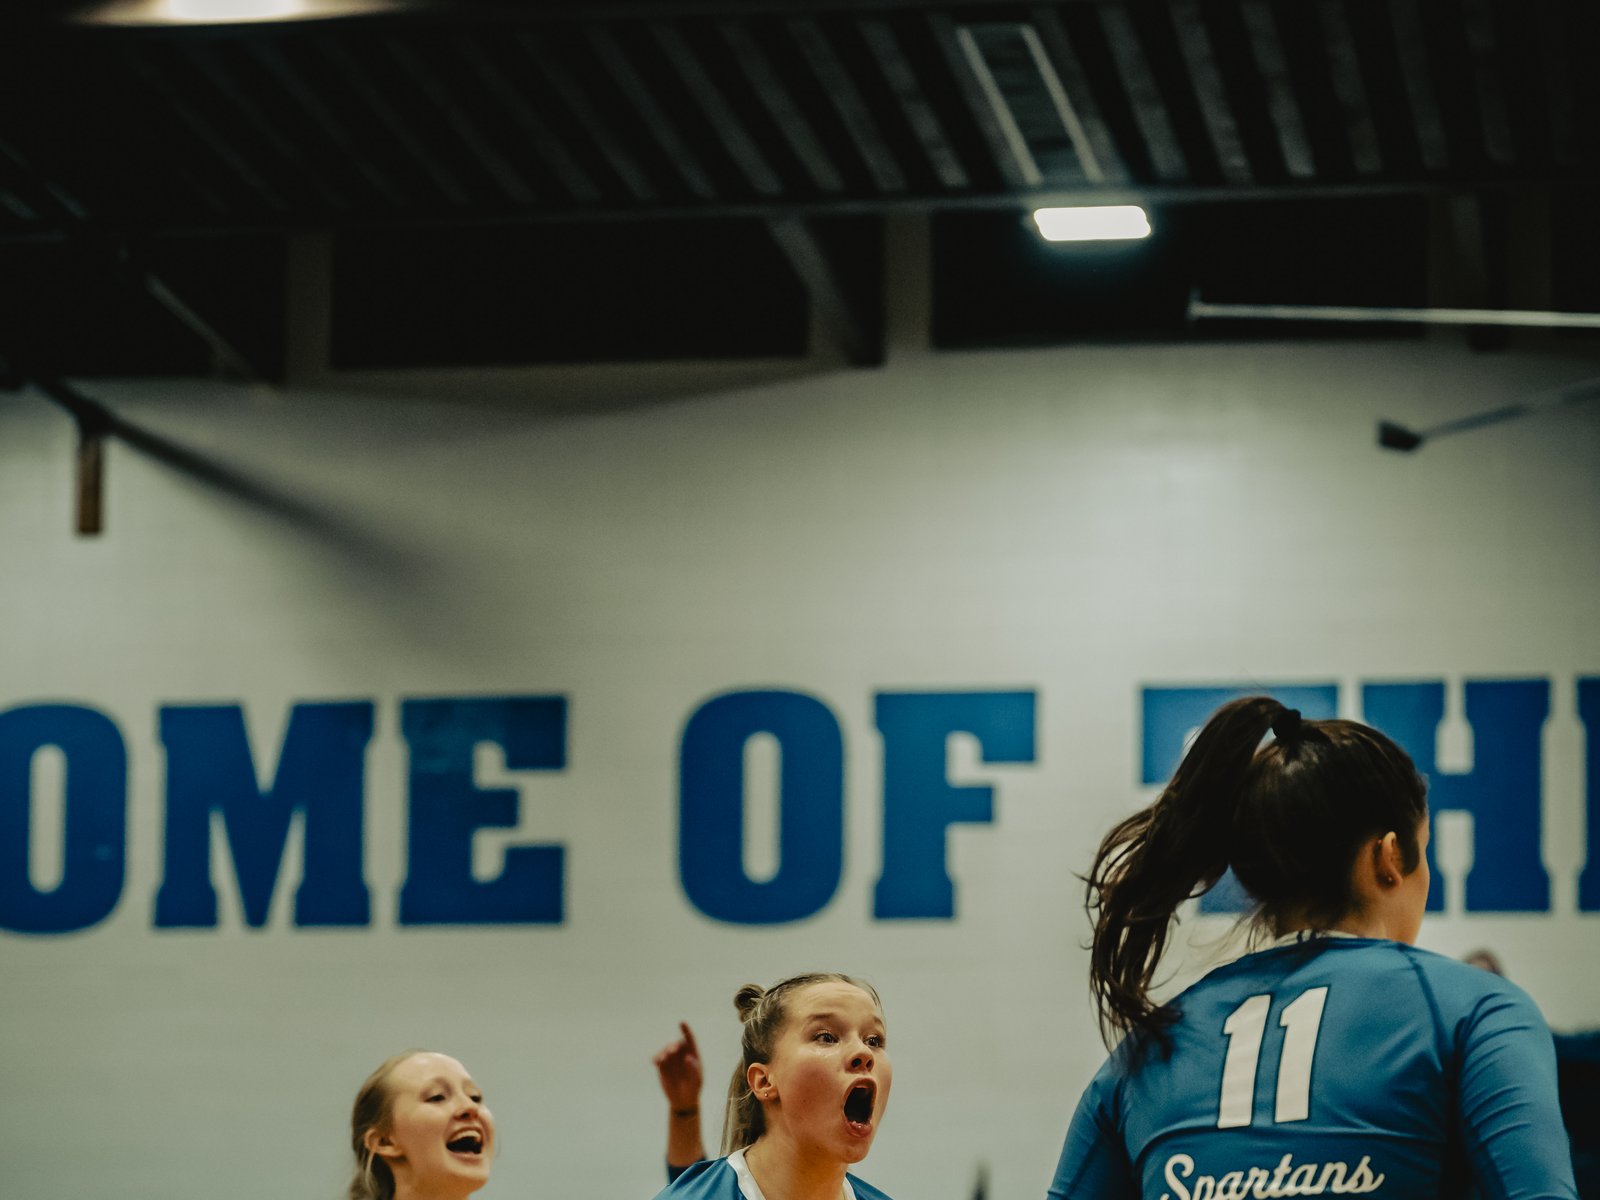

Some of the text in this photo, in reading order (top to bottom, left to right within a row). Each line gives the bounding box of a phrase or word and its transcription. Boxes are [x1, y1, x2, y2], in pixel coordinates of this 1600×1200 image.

[0, 677, 1600, 934] OME OF TH
[1217, 986, 1329, 1129] 11
